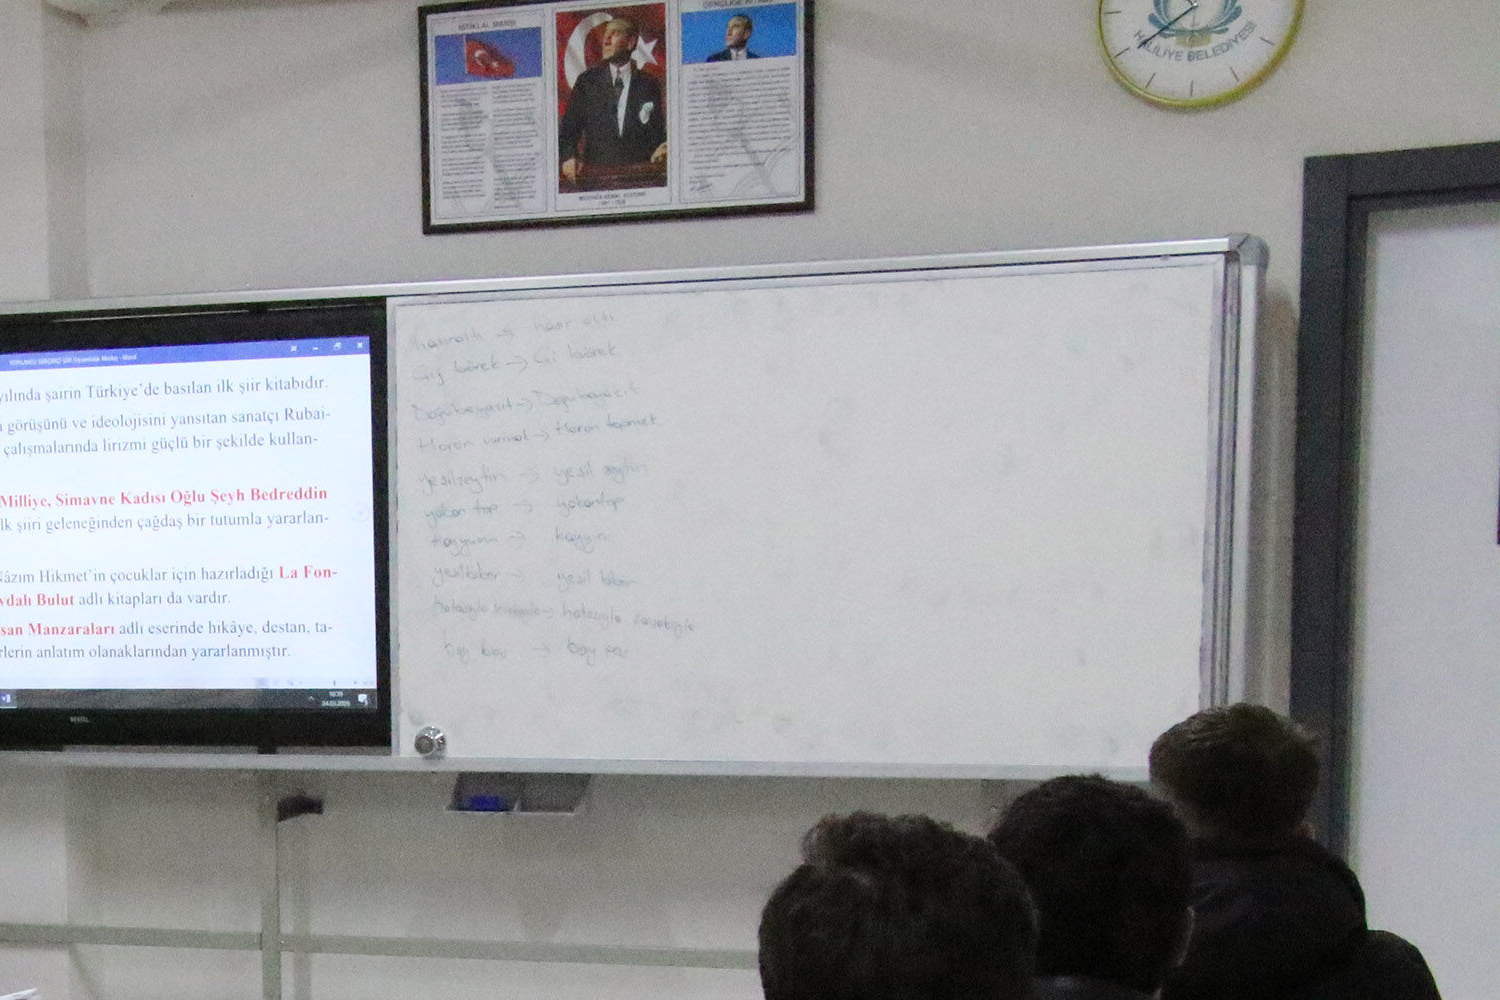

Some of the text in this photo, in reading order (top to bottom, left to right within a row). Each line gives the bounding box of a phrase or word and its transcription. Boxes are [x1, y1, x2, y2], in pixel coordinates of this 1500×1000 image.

[46, 390, 81, 403] şairin
[164, 381, 212, 395] basılan
[217, 379, 233, 393] ilk
[239, 379, 261, 394] şiir
[8, 418, 67, 435] görüşünü
[72, 420, 86, 429] ve
[92, 414, 166, 431] ideolojisini
[171, 413, 227, 429] yansıtan
[232, 411, 279, 424] sanatçı
[285, 407, 330, 421] Rubai-
[4, 439, 98, 458] çalışmalarında
[103, 437, 146, 451] lirizmi
[152, 436, 188, 454] güçlü
[193, 435, 212, 448] bir
[216, 433, 264, 450] şekilde
[269, 431, 318, 446] kullan-
[55, 493, 115, 506] Simavne
[121, 491, 166, 504] Kadısı
[170, 490, 205, 506] Oğlu
[210, 488, 245, 505] Şeyh
[250, 486, 327, 501] Bedreddin
[17, 518, 41, 533] şiiri
[46, 516, 132, 534] geleneğinden
[137, 514, 182, 531] çağdaş
[187, 513, 205, 526] bir
[211, 512, 262, 526] tutumla
[267, 510, 329, 529] yararlan-
[110, 568, 167, 584] çocuklar
[172, 568, 196, 583] için
[201, 566, 273, 583] hazırladığı
[279, 565, 298, 579] La
[304, 565, 337, 579] Fon-
[37, 593, 74, 606] Bulut
[79, 592, 103, 605] adlı
[108, 592, 162, 608] kitapları
[167, 591, 182, 604] da
[28, 622, 115, 636] Manzaraları
[119, 621, 143, 634] adlı
[148, 620, 203, 634] eserinde
[315, 622, 332, 633] ta-
[37, 645, 84, 658] anlatım
[89, 644, 187, 658] olanaklarından
